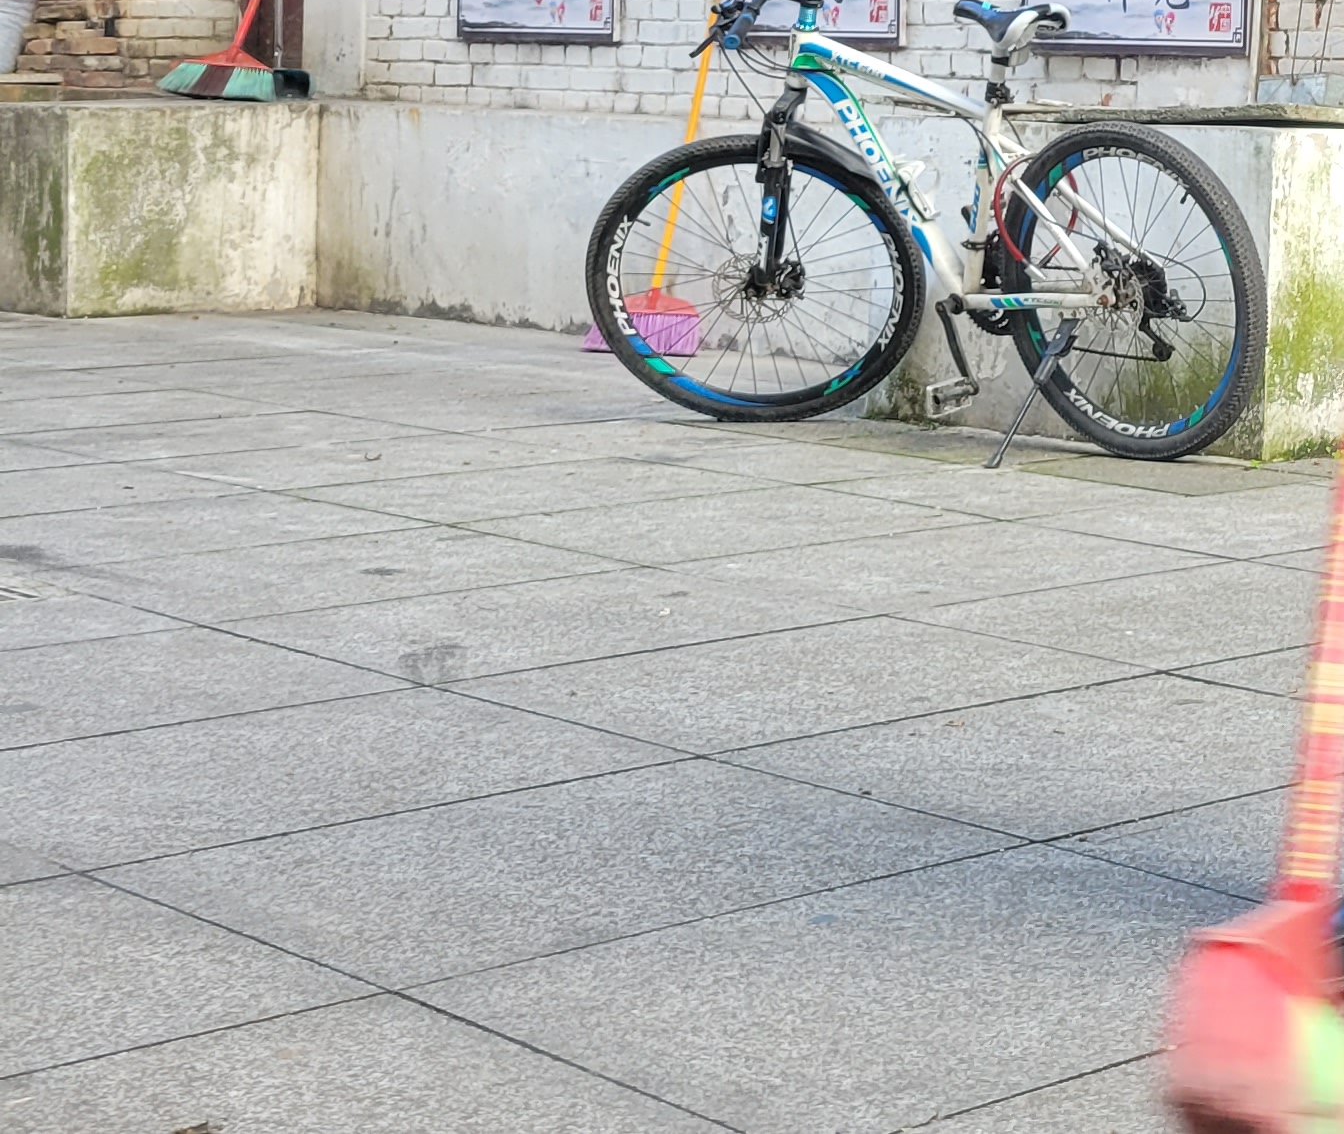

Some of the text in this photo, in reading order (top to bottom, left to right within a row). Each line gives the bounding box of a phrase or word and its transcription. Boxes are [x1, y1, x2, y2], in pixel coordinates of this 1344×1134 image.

[1082, 146, 1190, 189] PHOENIX
[606, 214, 637, 336] PHOENIX
[877, 231, 905, 353] PHOENIX
[1063, 387, 1171, 439] PHOENIX
